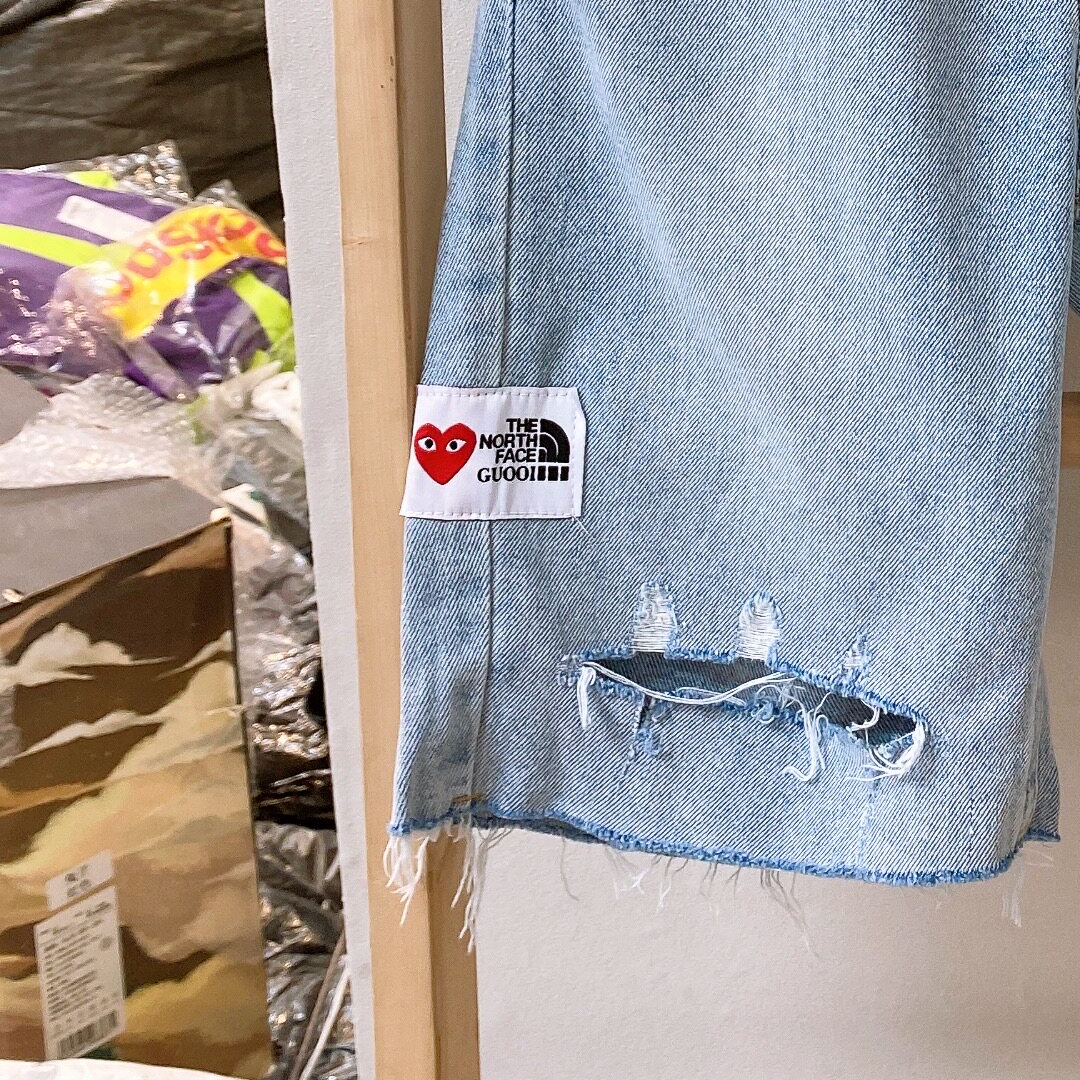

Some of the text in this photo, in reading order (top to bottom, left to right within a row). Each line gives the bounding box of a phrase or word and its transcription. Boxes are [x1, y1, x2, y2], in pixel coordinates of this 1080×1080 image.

[505, 418, 539, 433] THE
[479, 433, 538, 450] NORTH
[495, 448, 537, 464] FACE
